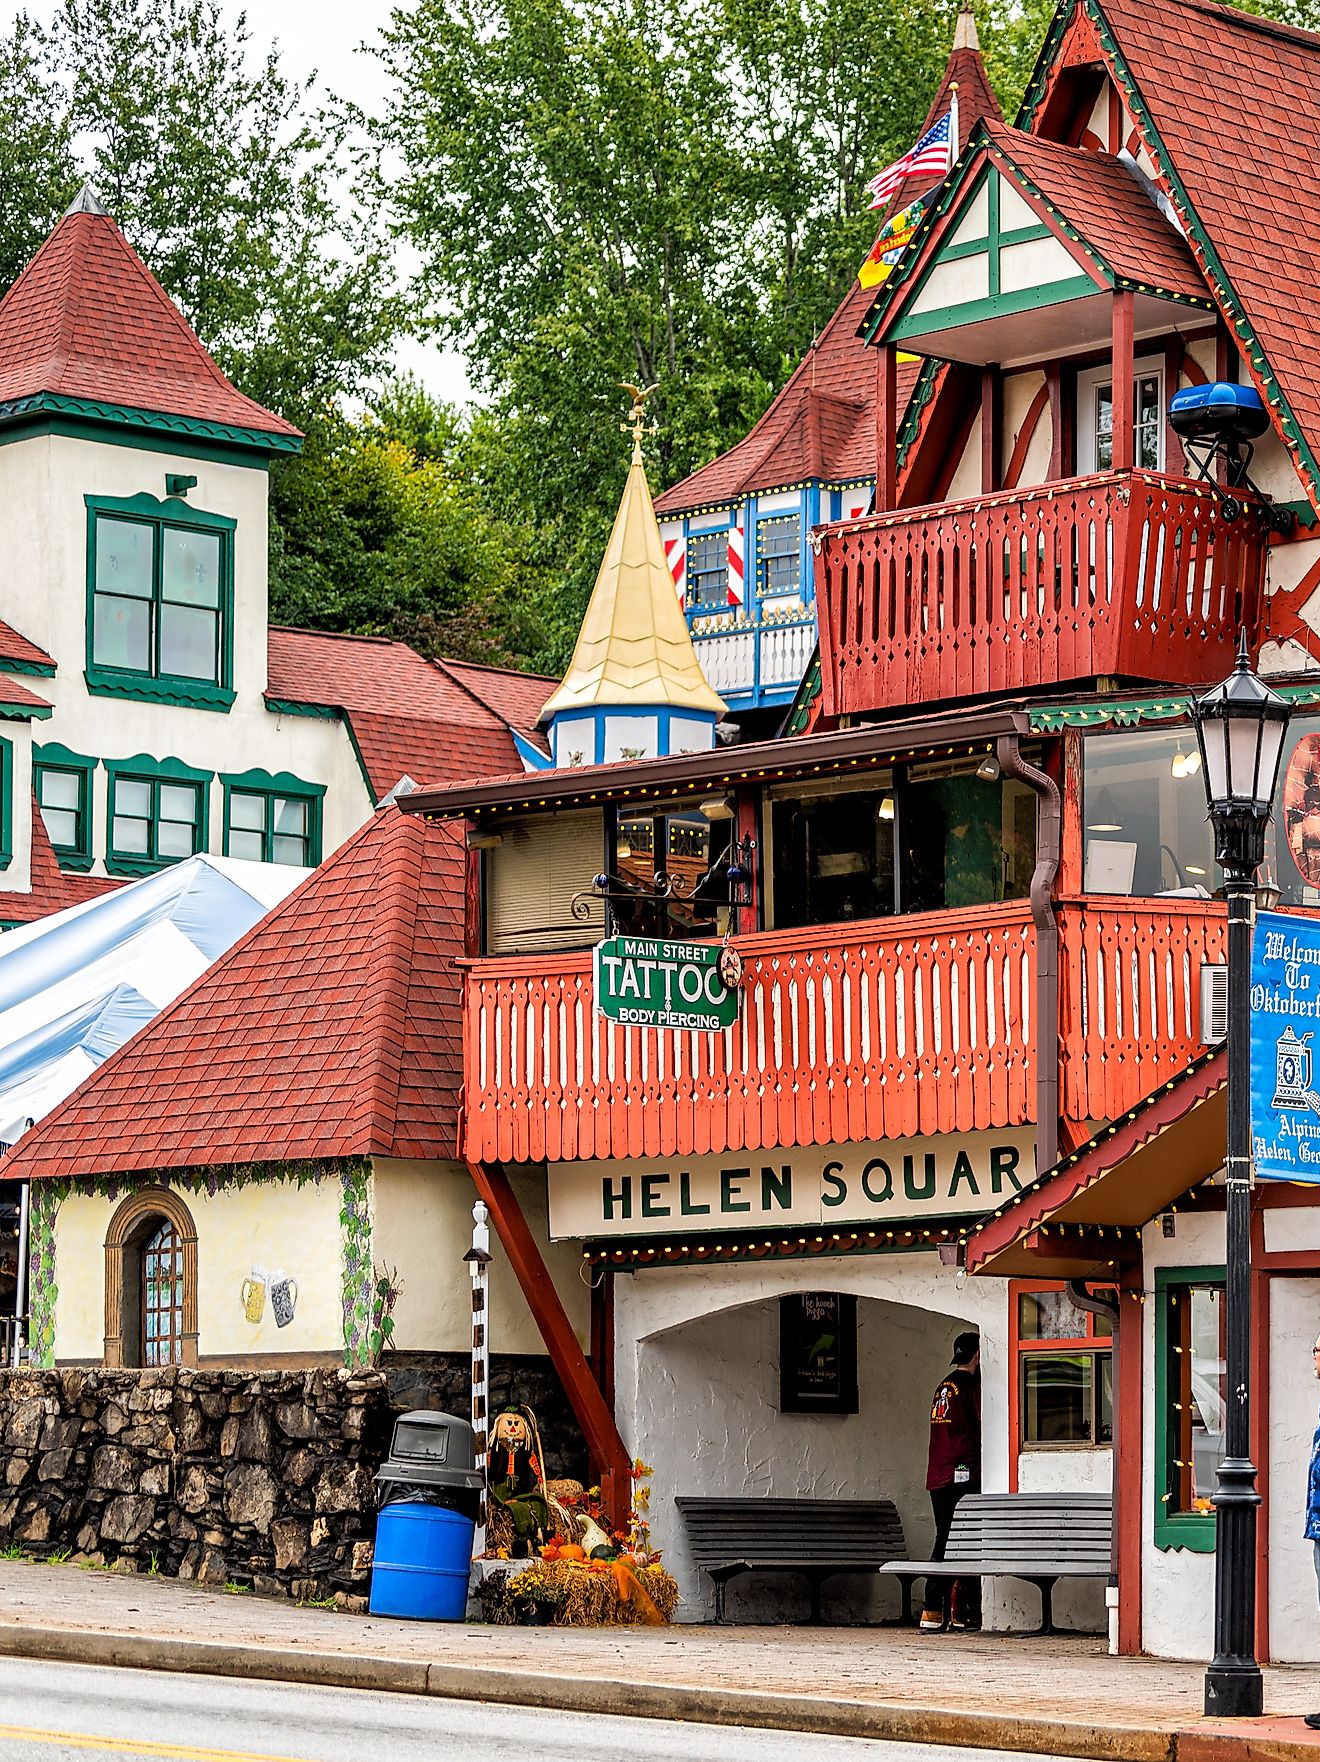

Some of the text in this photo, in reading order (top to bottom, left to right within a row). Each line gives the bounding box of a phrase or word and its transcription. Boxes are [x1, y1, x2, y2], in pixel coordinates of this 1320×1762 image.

[624, 940, 709, 961] MAIN STREET
[602, 955, 728, 1005] TATTOO
[1285, 962, 1311, 989] To
[618, 1007, 720, 1030] BODY PIERCING
[1254, 1136, 1296, 1164] Helen,
[602, 1145, 1039, 1220] HELEN SQUAR
